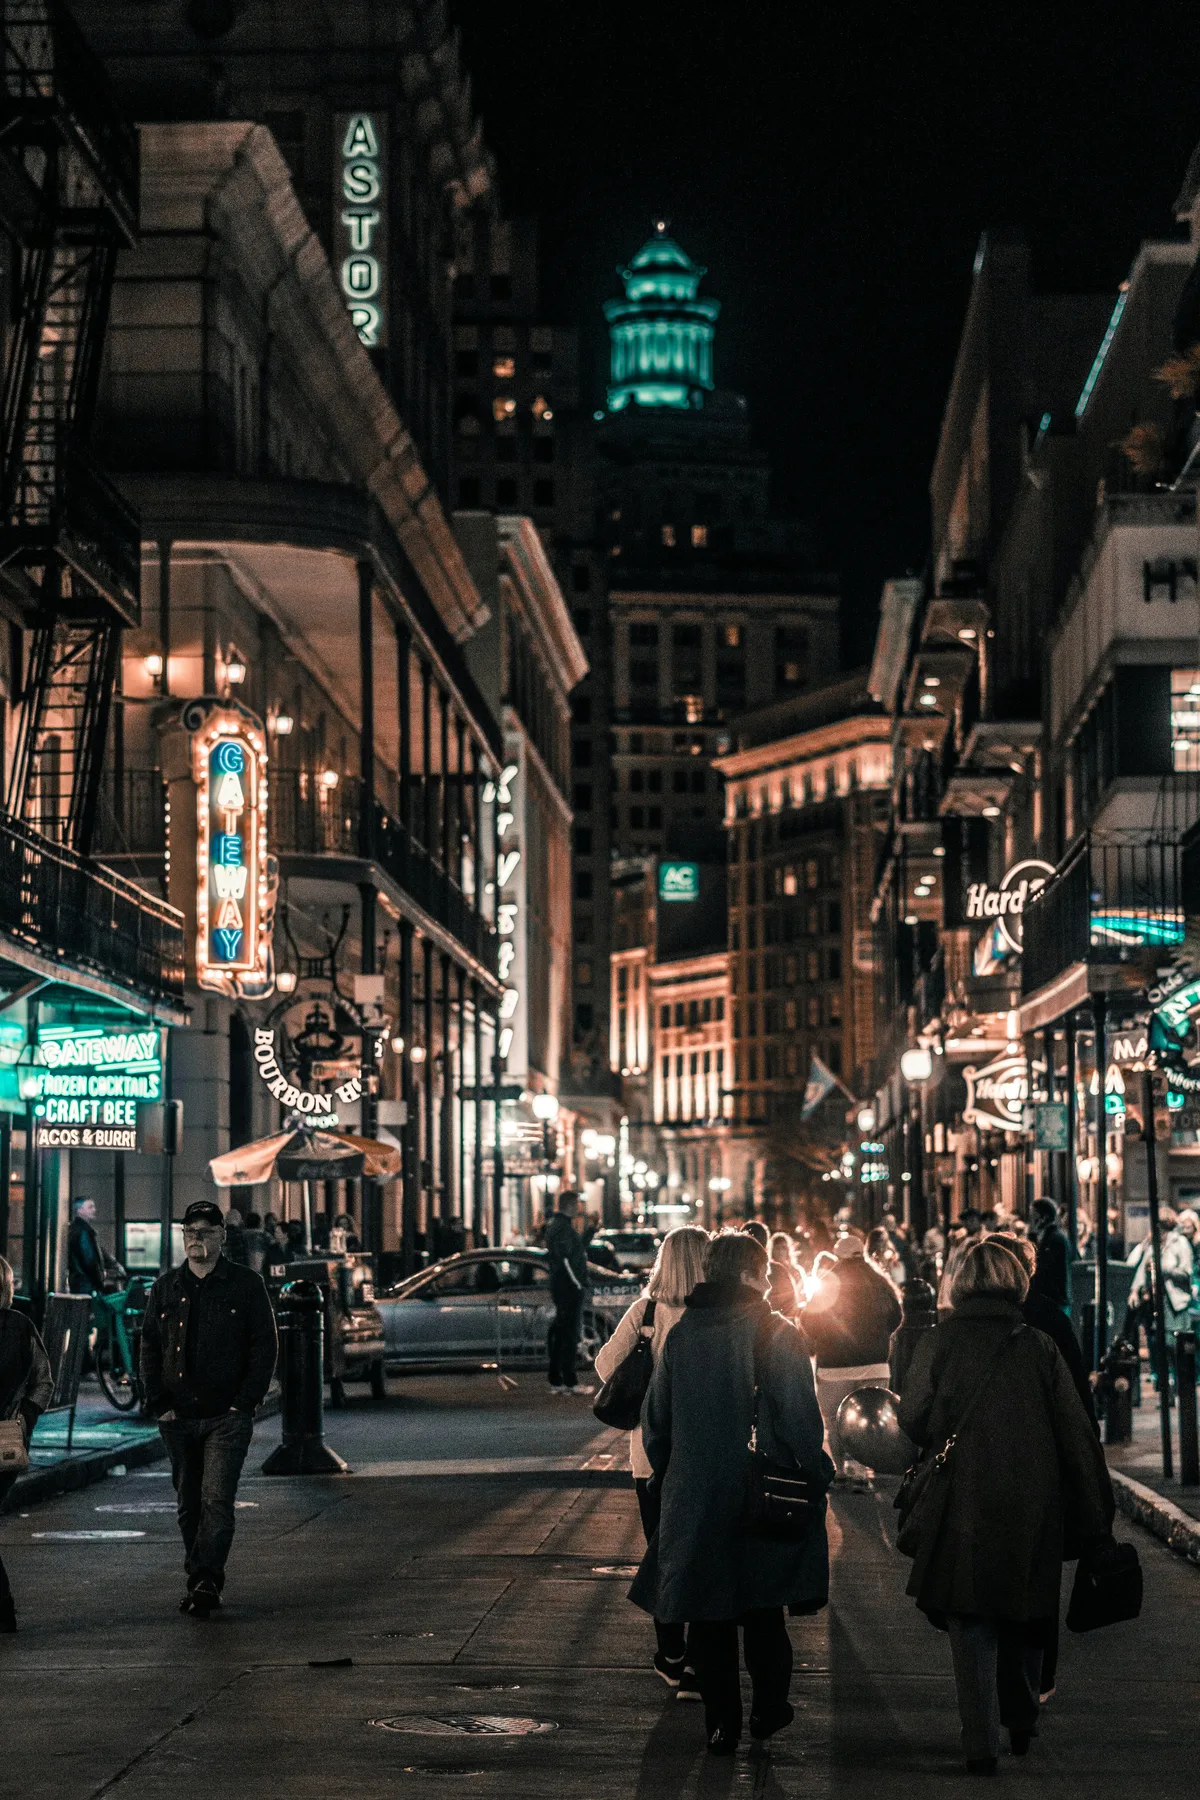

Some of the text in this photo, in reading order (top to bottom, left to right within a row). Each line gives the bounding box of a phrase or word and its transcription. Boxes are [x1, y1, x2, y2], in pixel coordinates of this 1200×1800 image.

[342, 115, 380, 346] ASTOR
[214, 742, 248, 959] GATEWAY
[663, 866, 694, 885] AC
[966, 880, 1029, 918] Hard
[40, 1032, 158, 1069] GATEWAY
[88, 1073, 160, 1099] COCKTAILS
[254, 1028, 332, 1114] BOURBON
[46, 1098, 136, 1126] CRAFT BEE
[82, 1129, 95, 1146] &
